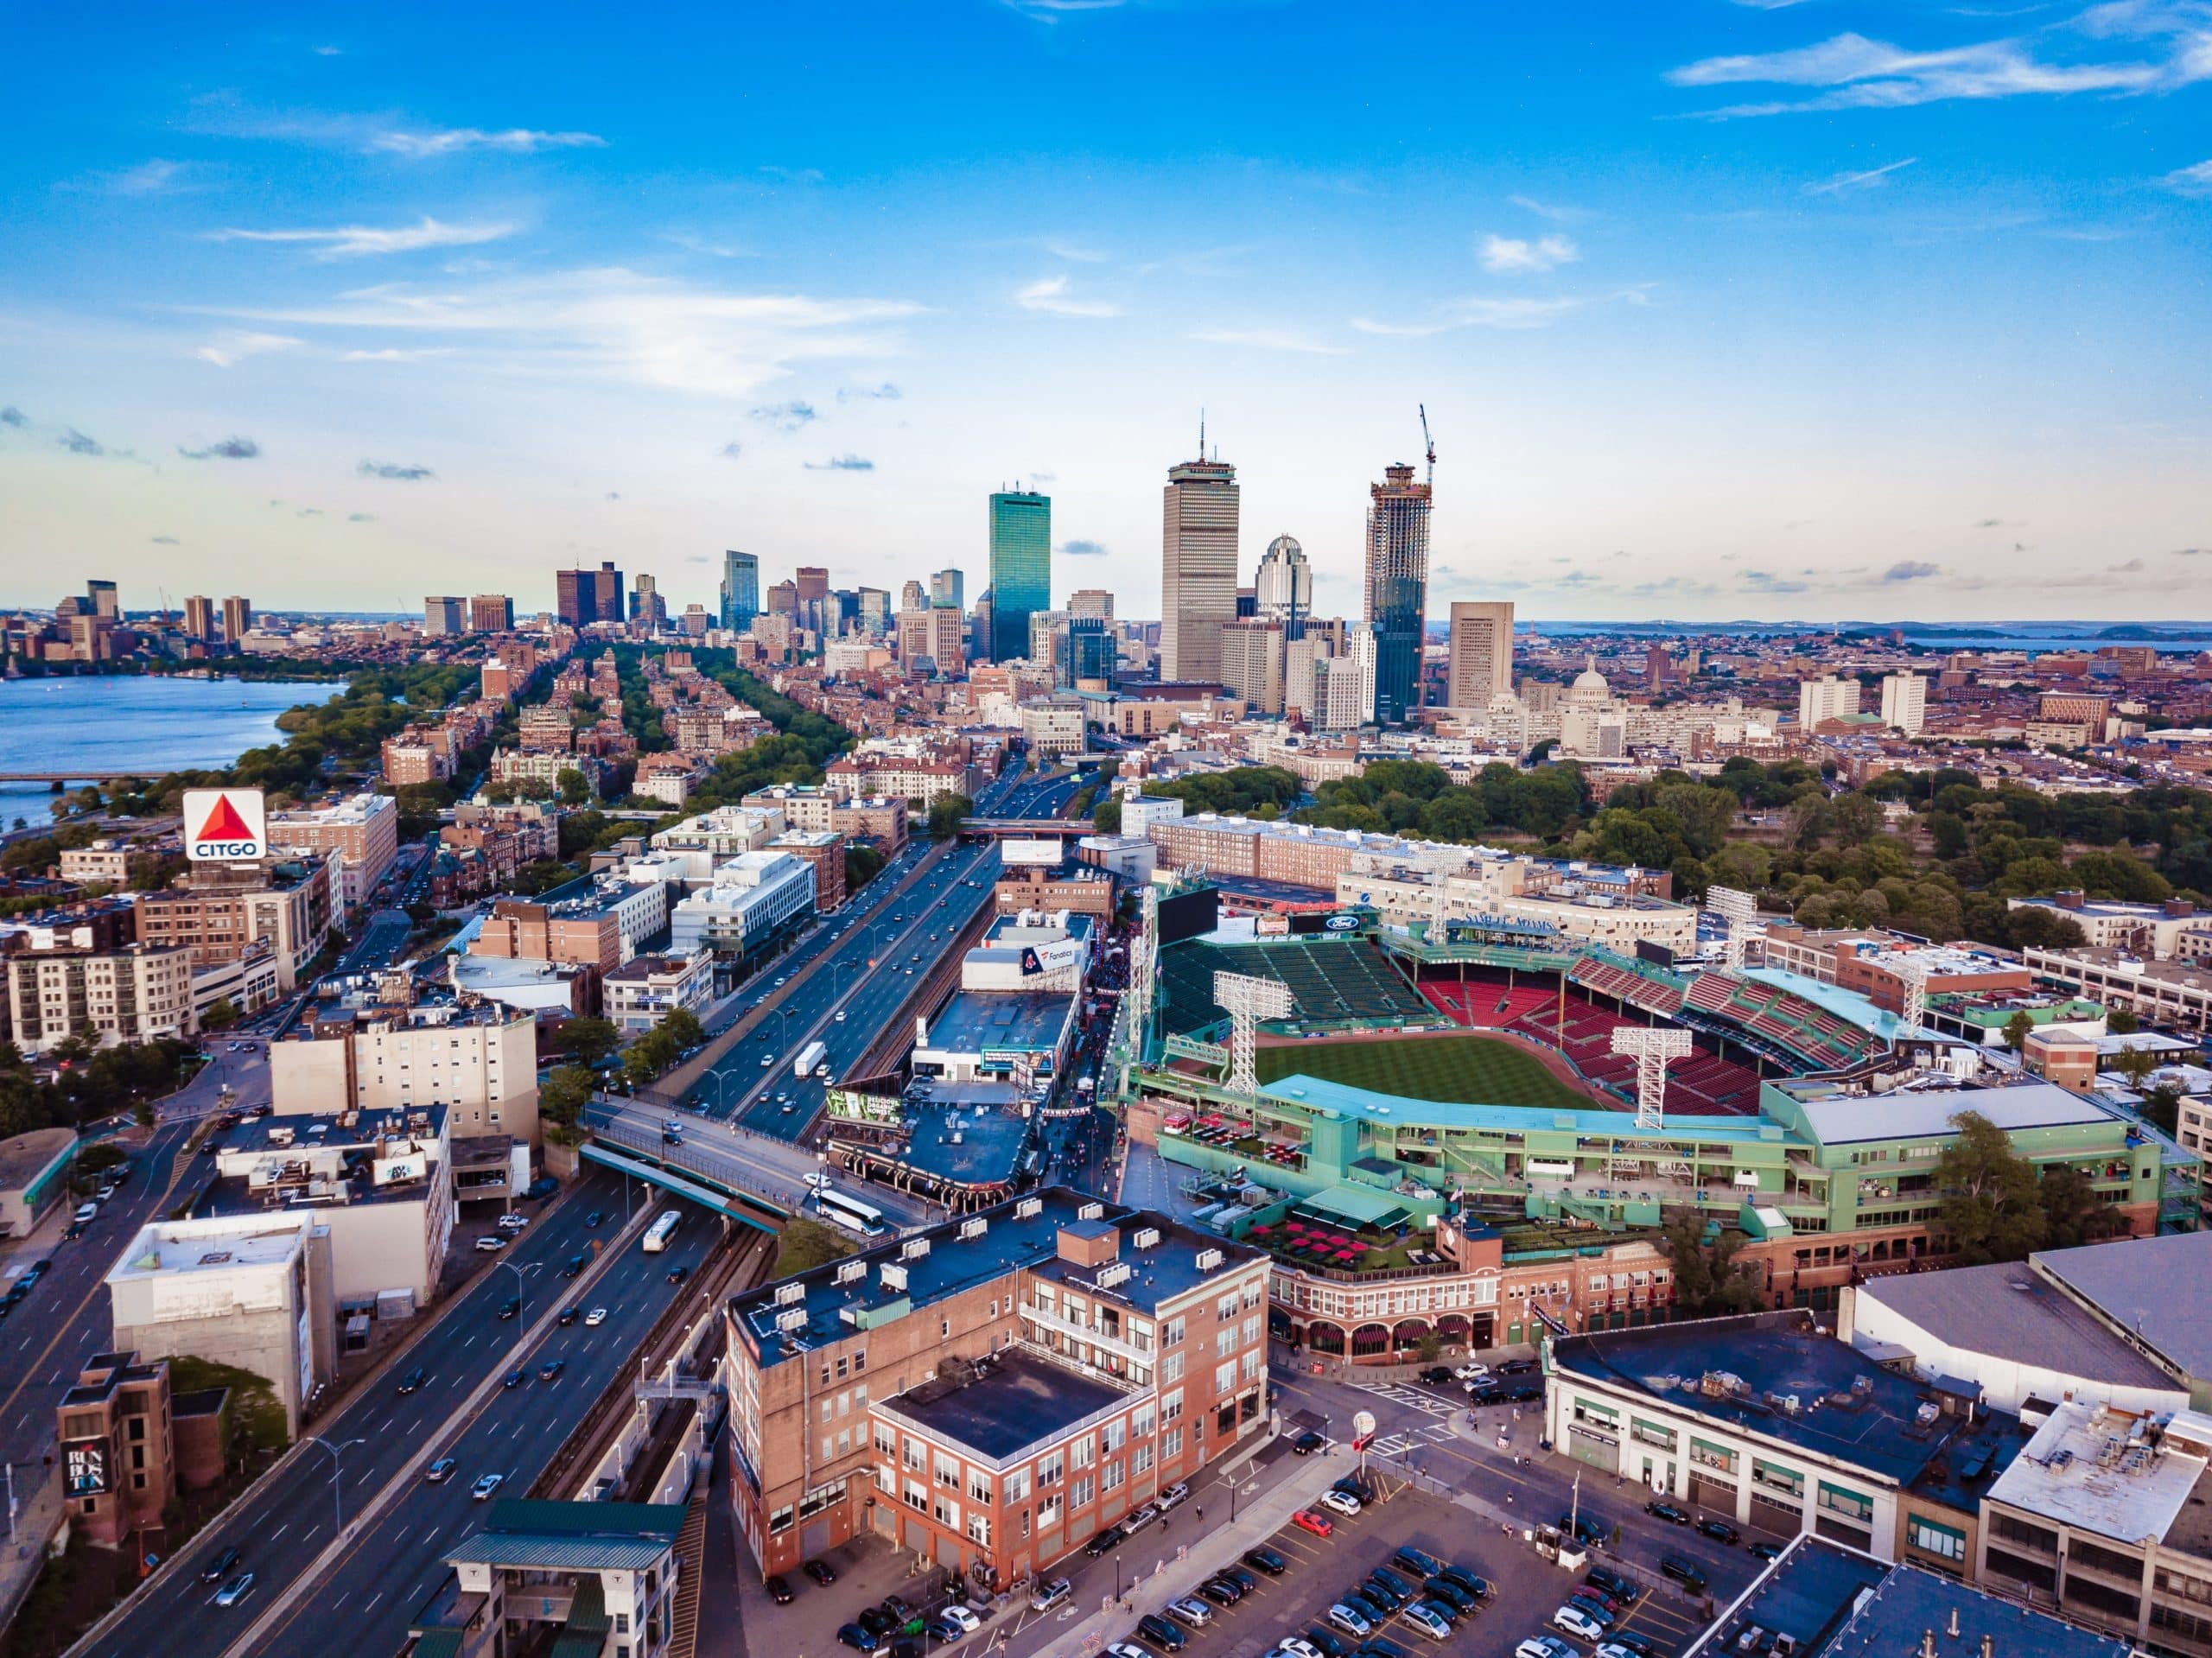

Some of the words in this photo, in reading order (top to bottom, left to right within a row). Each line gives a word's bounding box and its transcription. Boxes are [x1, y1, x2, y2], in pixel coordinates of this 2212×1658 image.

[196, 843, 257, 856] CITGO
[1332, 918, 1352, 928] Ford
[1516, 916, 1555, 930] ADAMS
[1049, 950, 1072, 961] Fanatics
[69, 1451, 102, 1464] RUN
[70, 1464, 103, 1477] BOS
[70, 1475, 104, 1490] TON
